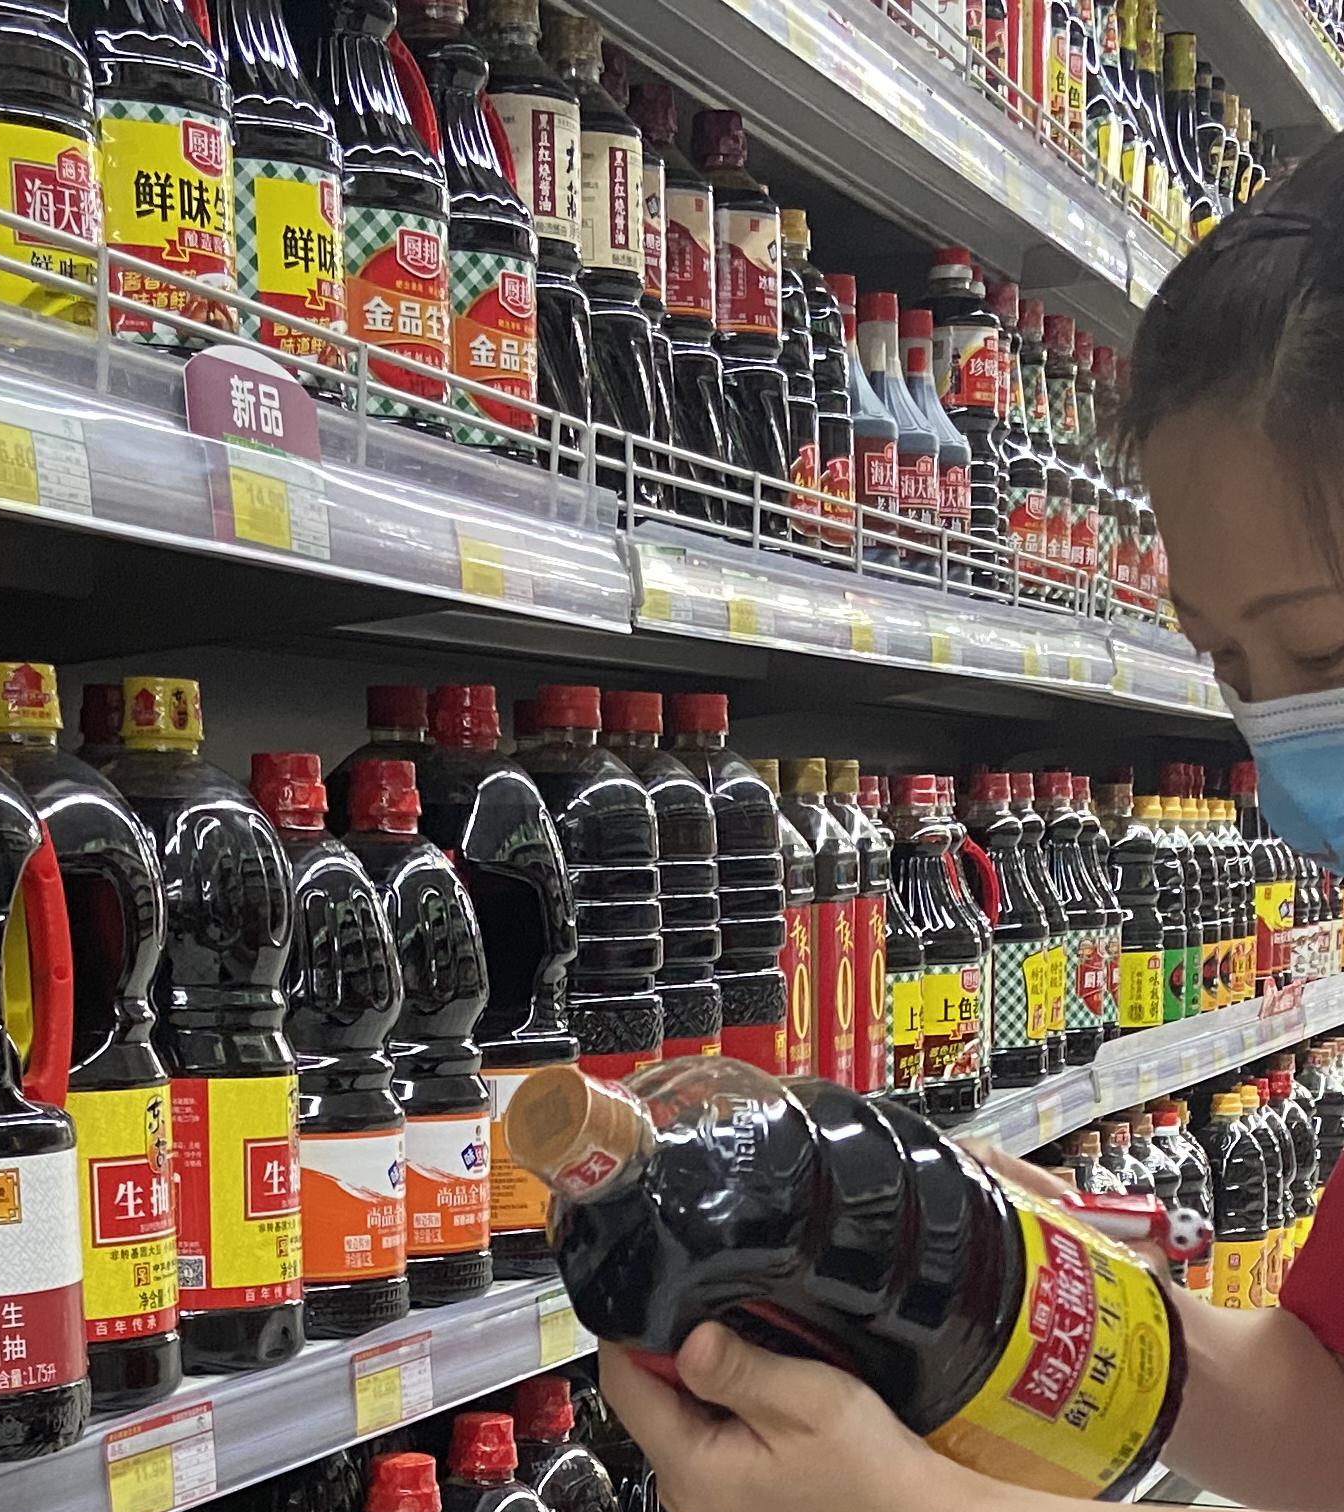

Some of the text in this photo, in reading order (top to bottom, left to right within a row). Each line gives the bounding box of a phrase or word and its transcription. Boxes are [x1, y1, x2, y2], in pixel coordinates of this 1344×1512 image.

[229, 375, 286, 437] 新品
[113, 1175, 170, 1222] 生抽
[1, 1301, 28, 1362] 生抽
[95, 1313, 159, 1338] 百年传承
[1024, 1232, 1088, 1402] 海天酱油
